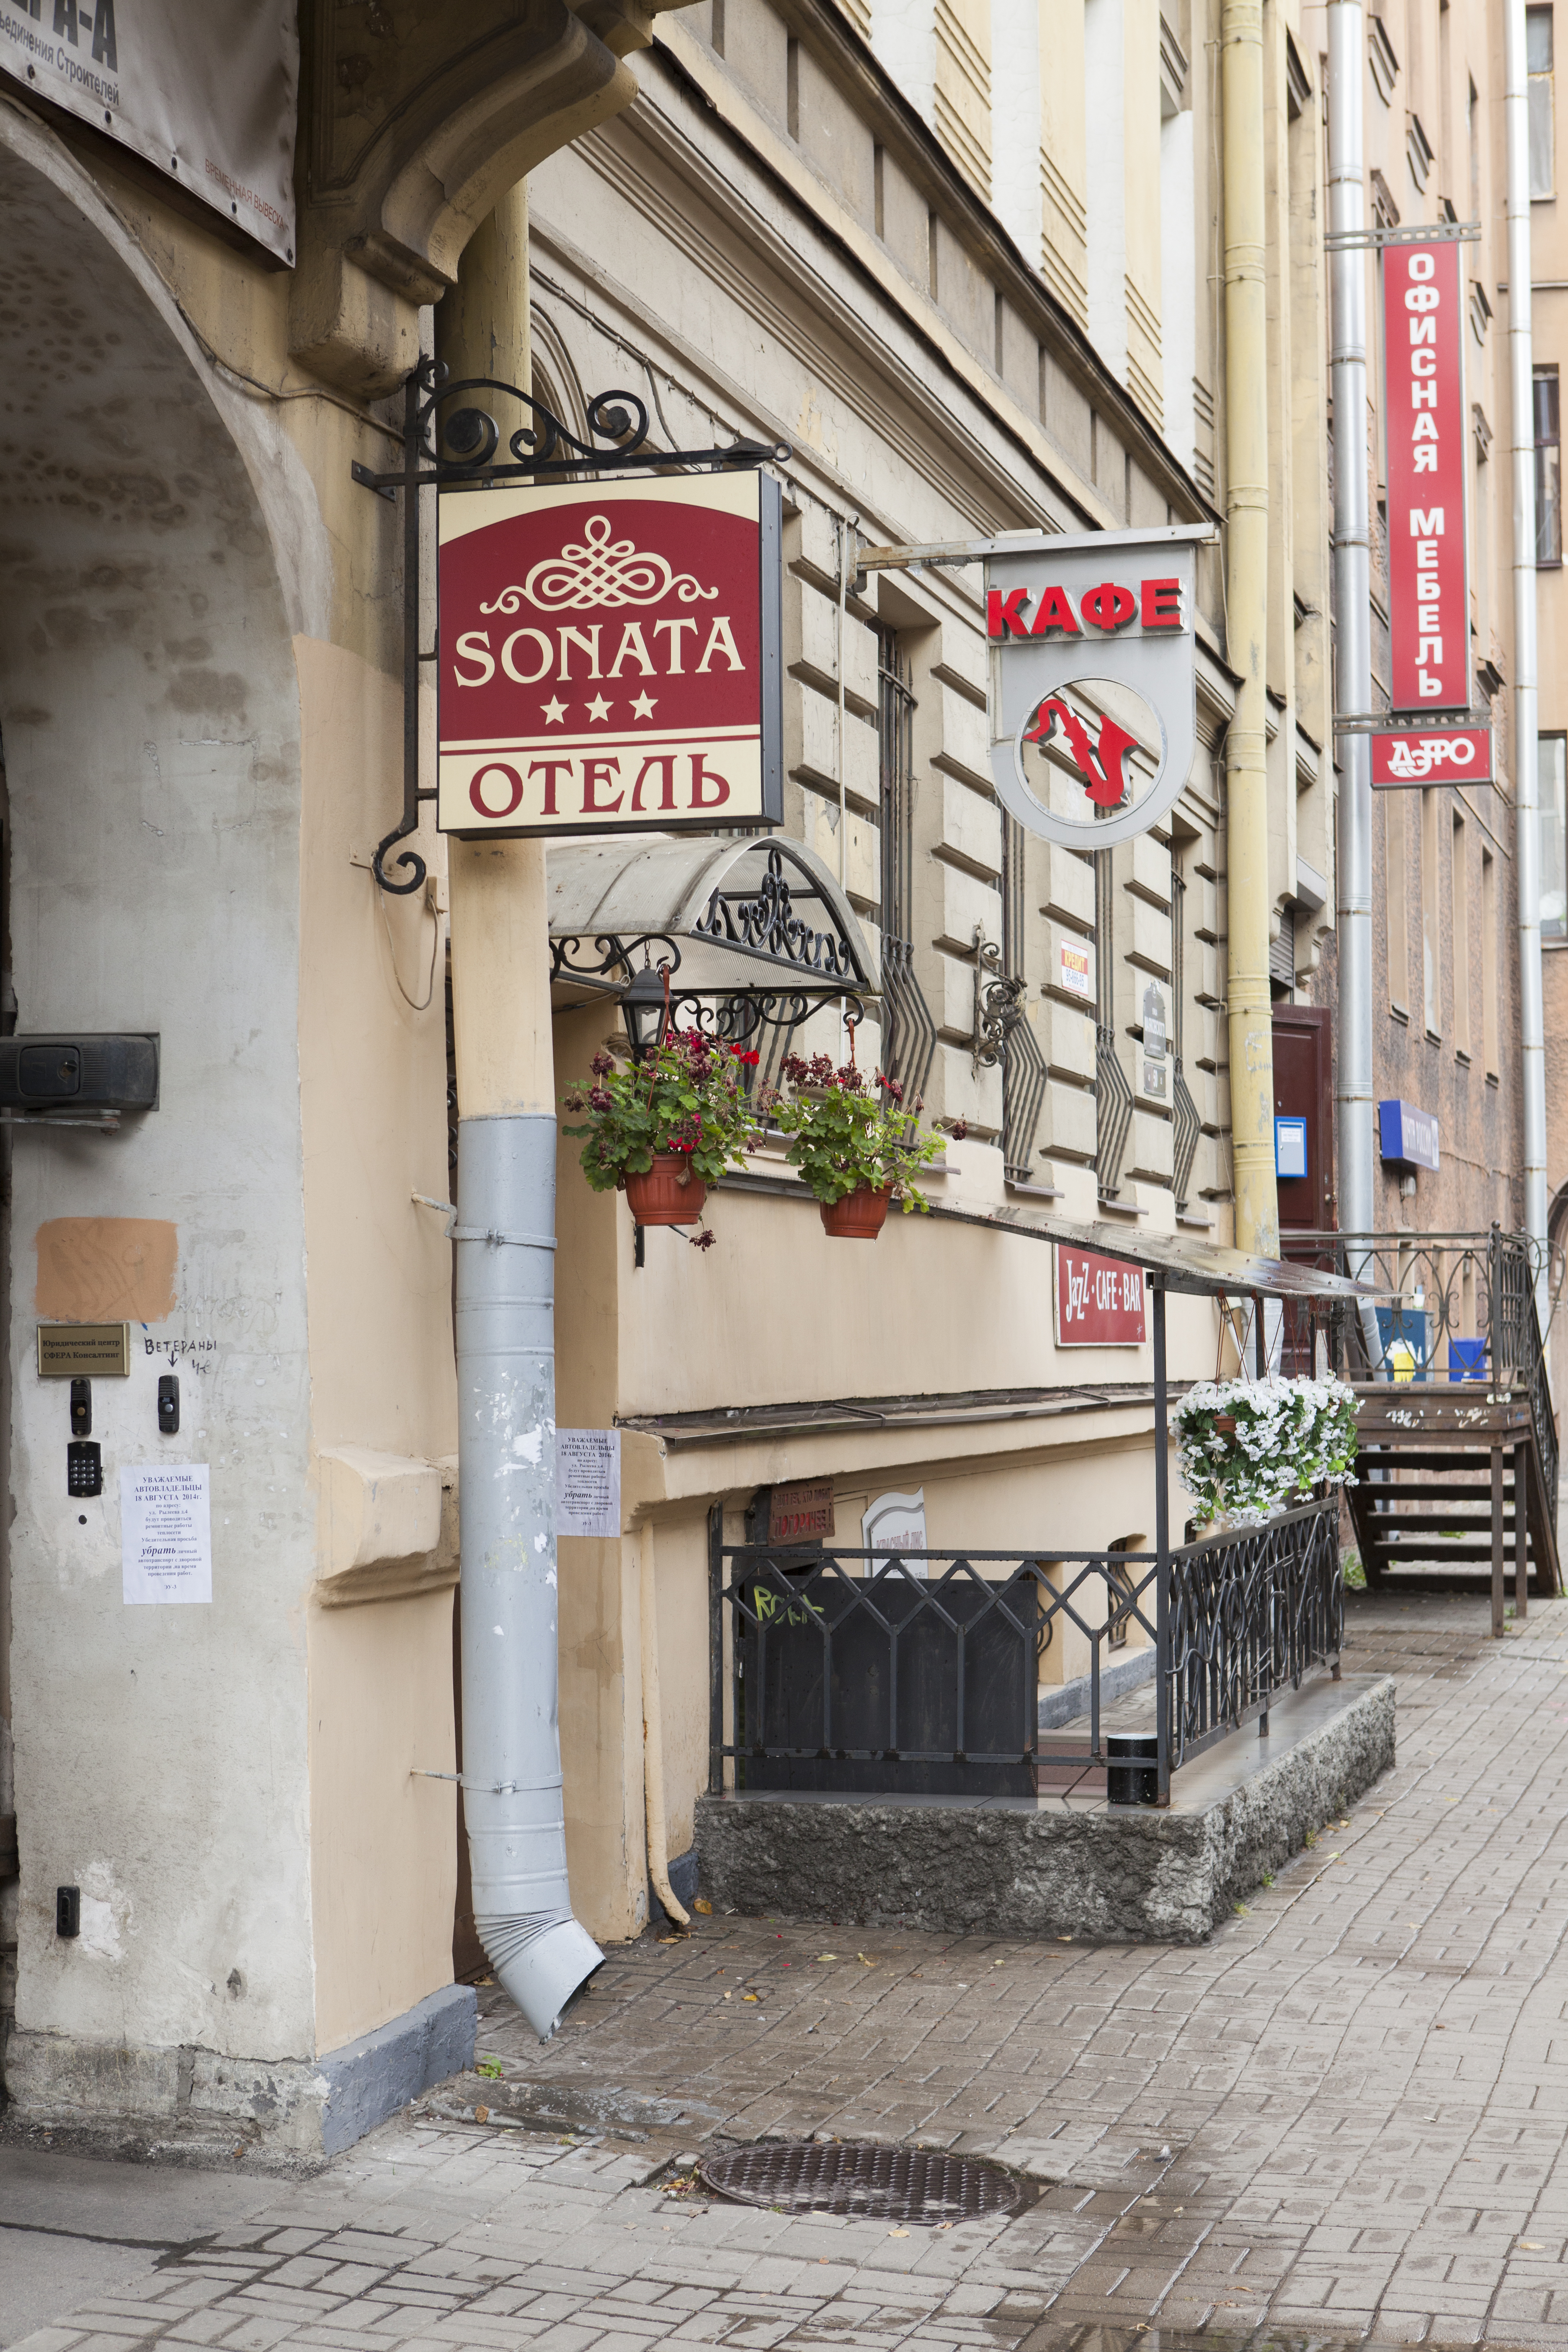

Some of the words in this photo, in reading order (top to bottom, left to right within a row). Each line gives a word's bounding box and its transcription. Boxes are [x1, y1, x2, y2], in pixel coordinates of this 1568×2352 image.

[57, 47, 119, 106] Строителей
[205, 158, 252, 205] ВРЕМЕННАЯ
[254, 194, 285, 231] ВЫВЕСКА
[1404, 253, 1440, 473] ОФИСНАЯ
[987, 578, 1184, 639] КАФЕ
[1409, 507, 1445, 697] МЕБЕЛЬ
[454, 616, 745, 687] SONATA
[1387, 737, 1475, 778] ДЭФО
[469, 753, 730, 819] ОТЕЛЬ
[1064, 950, 1085, 973] КРЕДИТ
[1096, 1269, 1117, 1310] CAFE
[1123, 1273, 1141, 1312] BAR
[43, 1339, 96, 1348] Юридический
[563, 1491, 592, 1499] убрать
[802, 1490, 812, 1503] КТО
[141, 1546, 176, 1557] убрать
